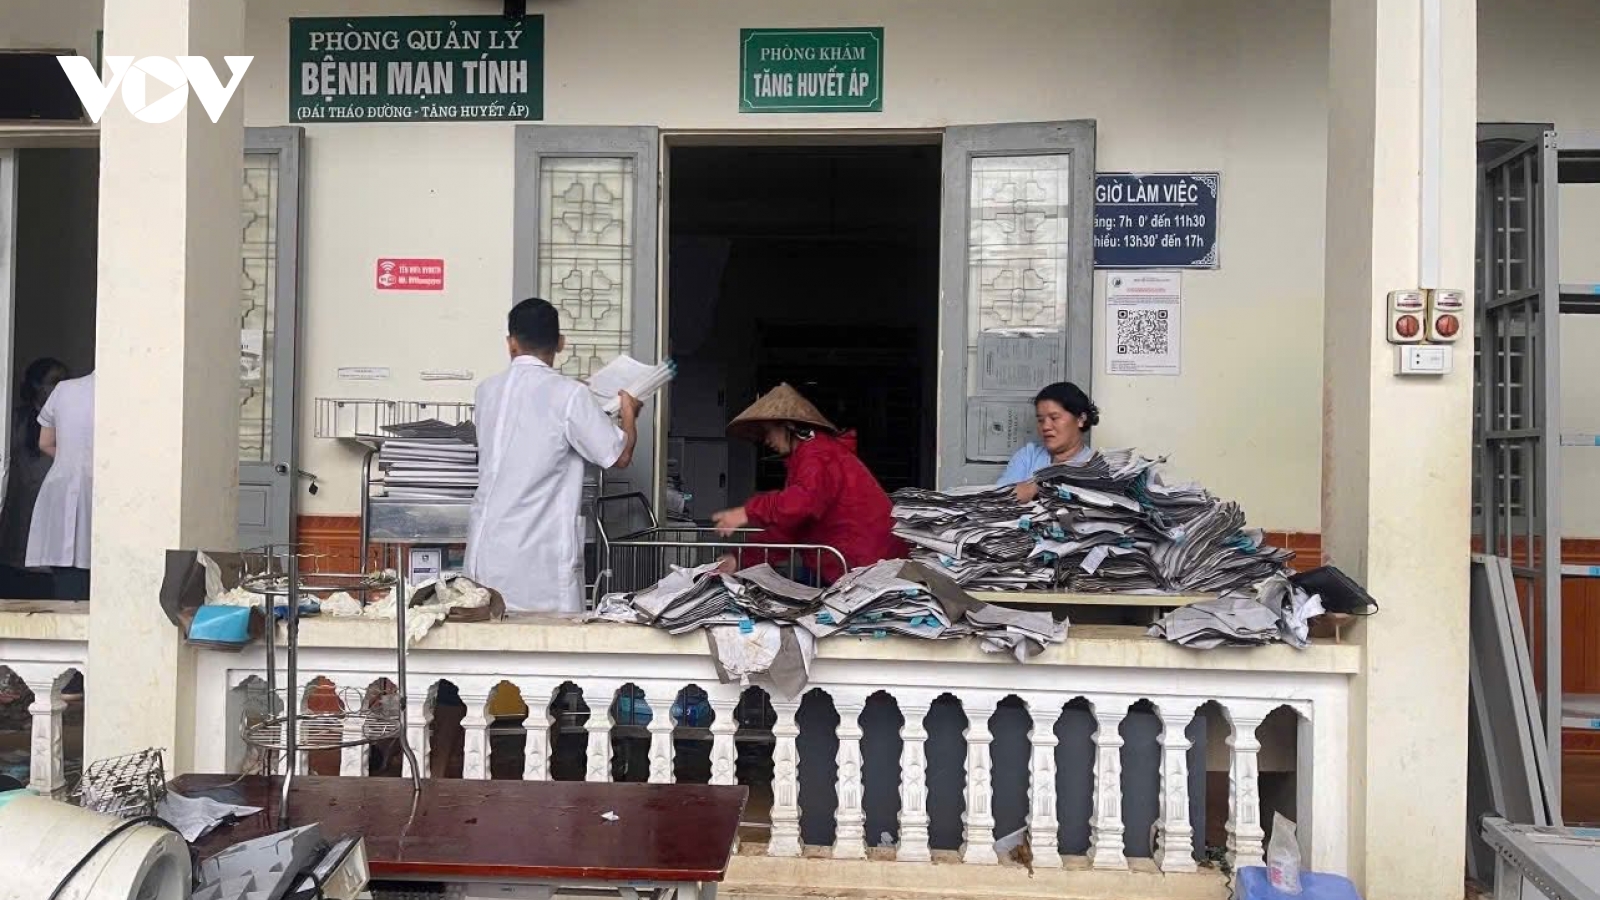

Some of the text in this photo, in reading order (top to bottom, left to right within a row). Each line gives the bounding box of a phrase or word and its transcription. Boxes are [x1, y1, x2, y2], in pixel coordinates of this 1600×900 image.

[309, 20, 523, 51] PHÒNG QUẢN LÝ
[760, 43, 866, 60] PHÒNG KHÁM
[302, 52, 528, 102] BỆNH MẠN TÍNH
[753, 64, 870, 97] TĂNG HUYẾT ÁP
[297, 103, 325, 119] (ĐÁI
[328, 103, 365, 118] THÁO
[367, 103, 412, 118] ĐƯỜNG
[421, 103, 457, 117] TĂNG
[460, 100, 505, 117] HUYẾT
[508, 102, 529, 118] ÁP)
[1095, 179, 1198, 207] GIỜ LÀM VIỆC
[1094, 214, 1116, 230] áng:
[1151, 213, 1171, 227] đến
[1174, 215, 1206, 227] 11h30
[1161, 233, 1181, 247] đến
[1185, 235, 1204, 247] 17h
